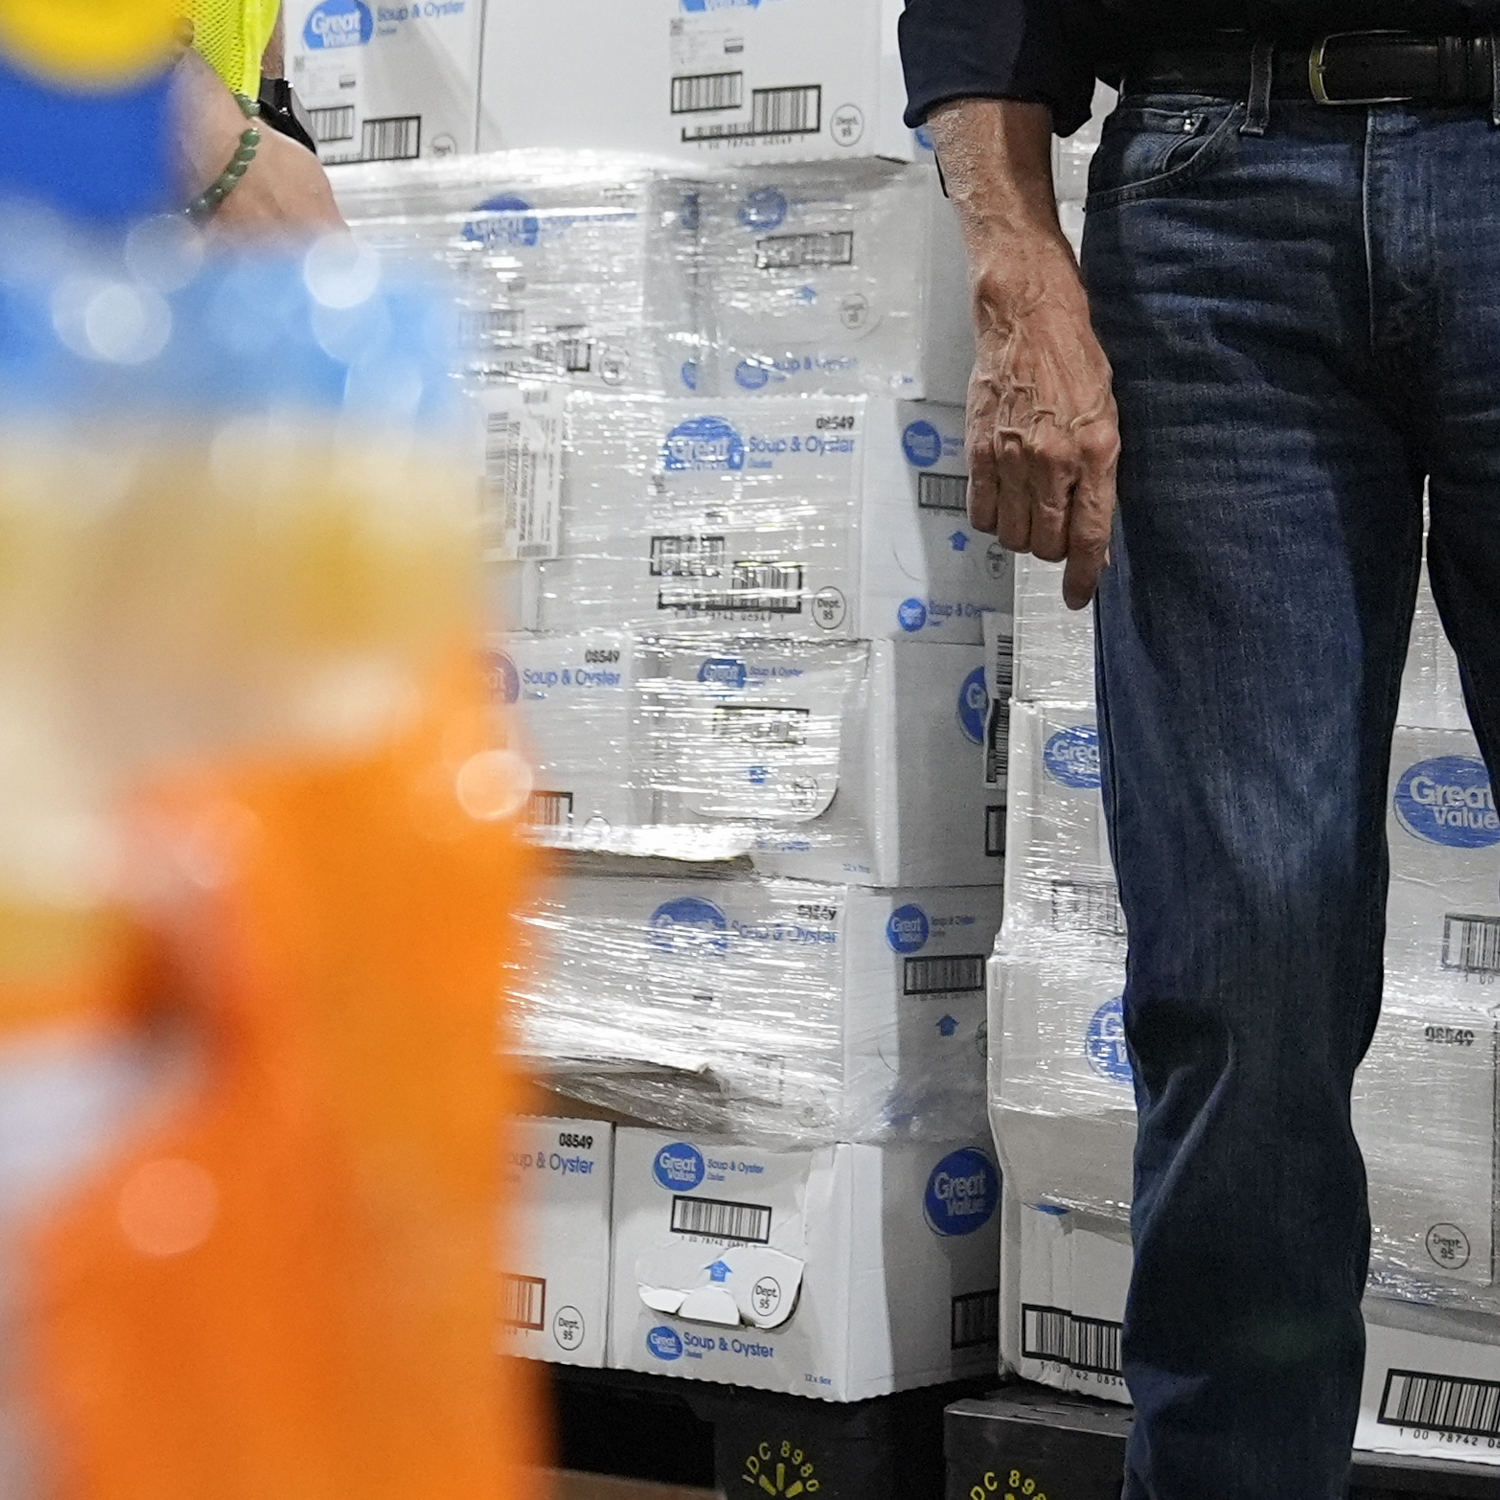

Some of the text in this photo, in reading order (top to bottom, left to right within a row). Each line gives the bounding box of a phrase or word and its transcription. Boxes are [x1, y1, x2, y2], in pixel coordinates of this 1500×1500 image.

[311, 9, 361, 34] Great
[377, 4, 409, 24] Soup
[423, 0, 466, 19] Oyster
[789, 435, 801, 451] &
[522, 668, 622, 688] Soup & Oyster
[1051, 739, 1099, 763] Grea
[1432, 805, 1499, 830] Value
[892, 916, 922, 933] Great
[558, 1132, 594, 1150] 08549
[549, 1152, 595, 1176] Oyster
[659, 1152, 697, 1173] Great
[706, 1158, 729, 1171] Soup
[738, 1161, 765, 1175] Oyster
[933, 1171, 988, 1201] Great
[945, 1197, 988, 1216] Value
[755, 1284, 779, 1298] Dept.
[683, 1331, 716, 1351] Soup
[718, 1337, 729, 1352] &
[731, 1338, 774, 1358] Oyster
[1096, 1375, 1124, 1386] 0854
[1413, 1429, 1429, 1441] 00
[1438, 1432, 1479, 1447] 78742
[741, 1440, 820, 1493] IDC 8980
[969, 1471, 998, 1500] DC
